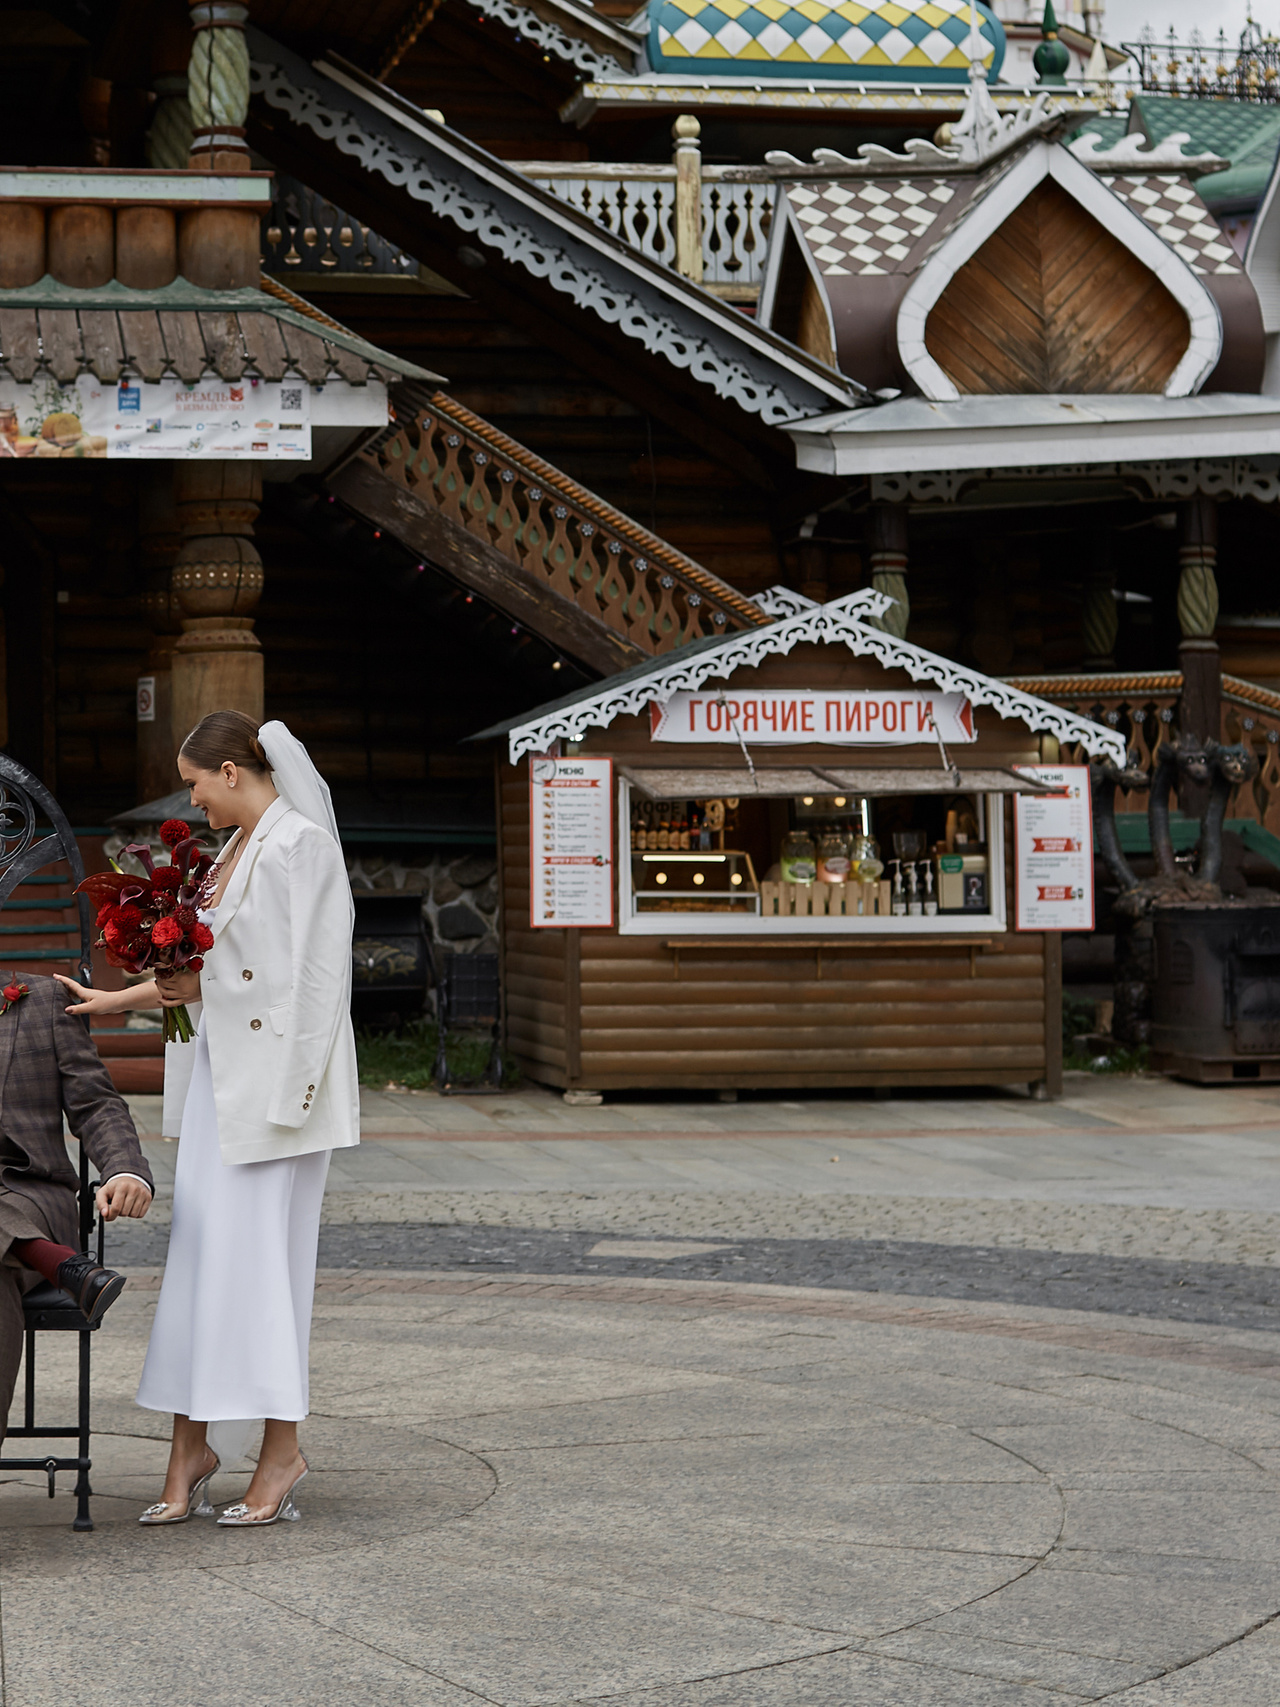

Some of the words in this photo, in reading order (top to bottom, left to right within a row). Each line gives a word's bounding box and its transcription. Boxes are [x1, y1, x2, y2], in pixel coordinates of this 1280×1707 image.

[176, 392, 229, 402] КРЕМЛЬ
[689, 700, 815, 732] ГОРЯЧИЕ
[825, 700, 934, 732] ПИРОГИ
[631, 800, 681, 815] КОФЕ
